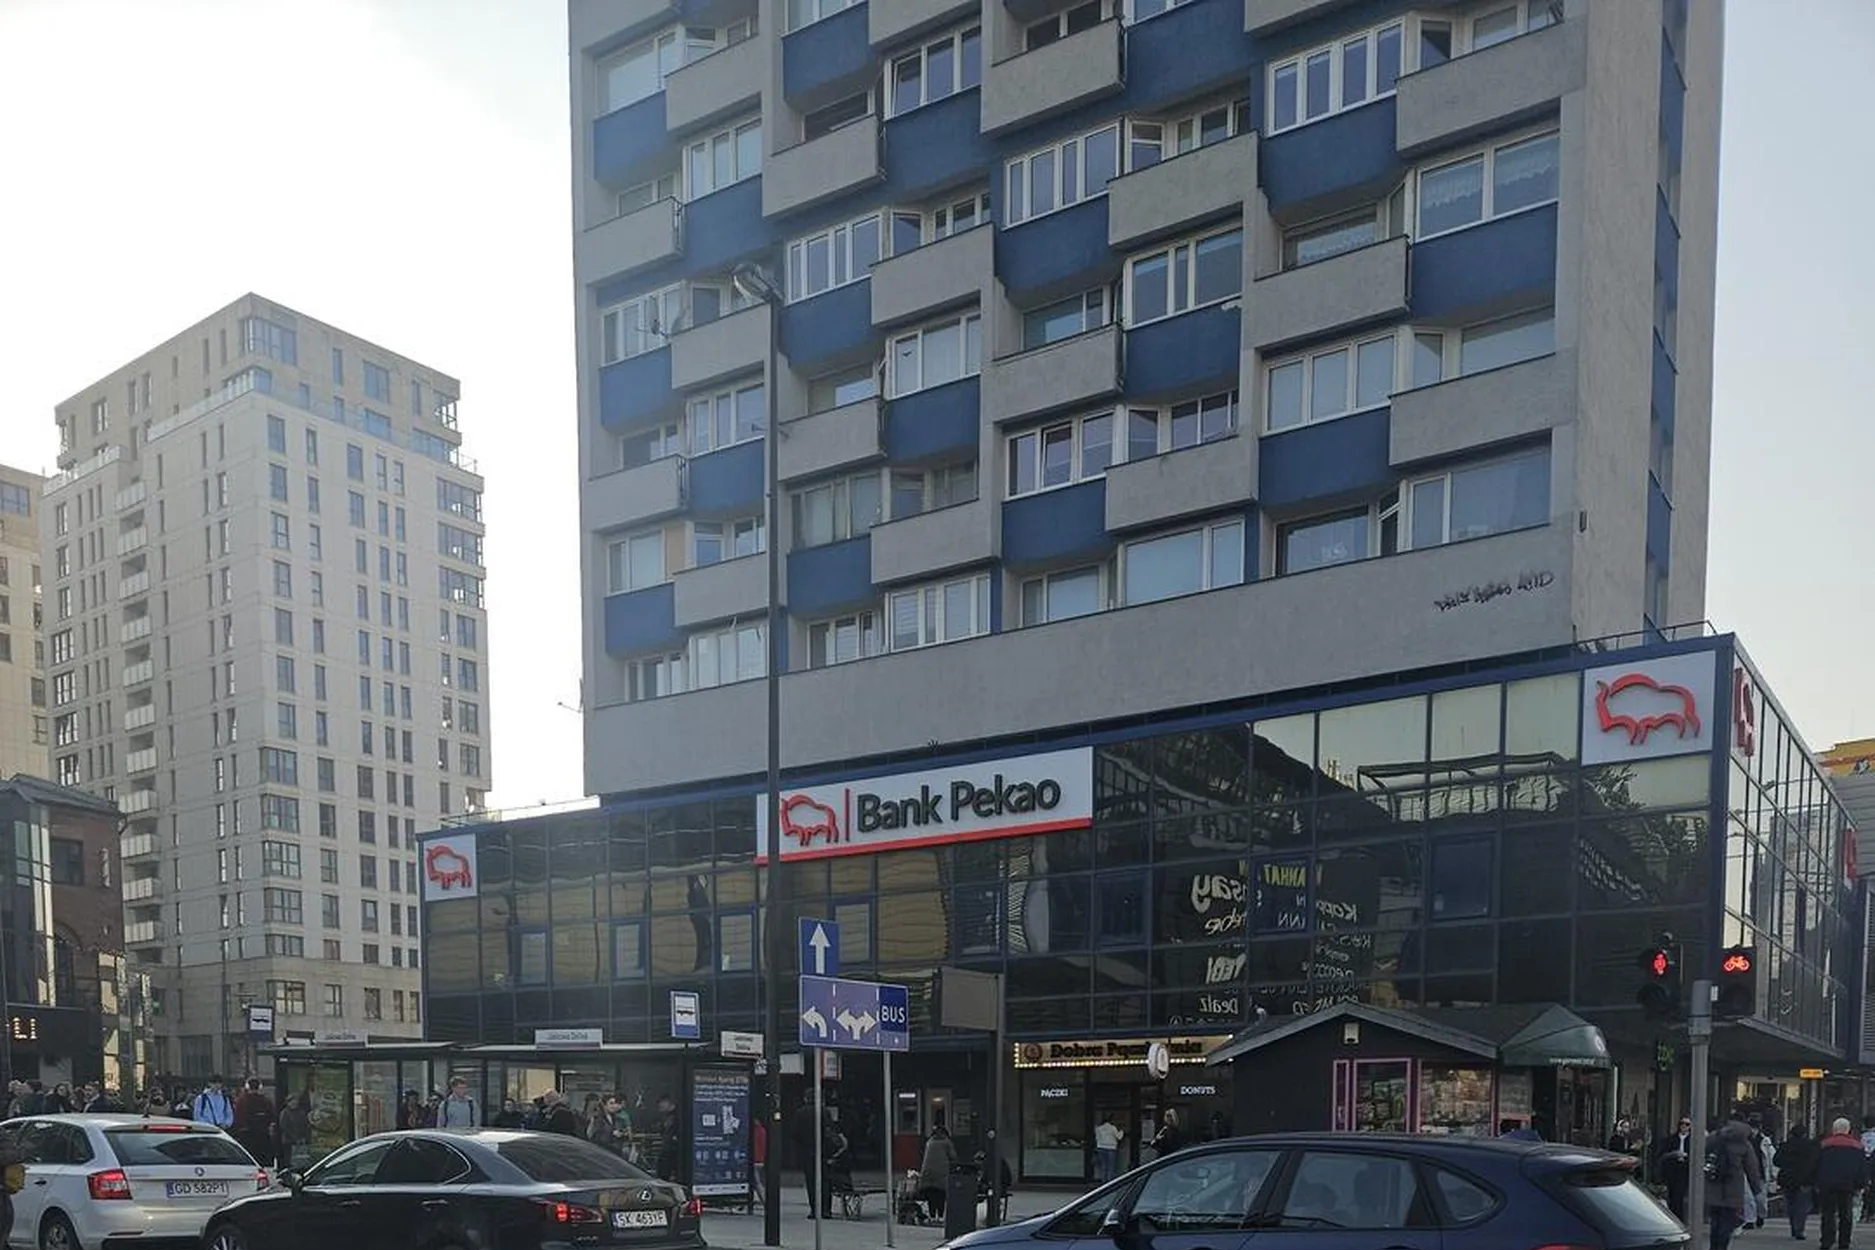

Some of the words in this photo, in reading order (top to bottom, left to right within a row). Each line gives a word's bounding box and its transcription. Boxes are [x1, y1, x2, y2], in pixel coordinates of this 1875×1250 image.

[857, 785, 943, 833] Bank
[950, 774, 1061, 822] Pekao
[881, 1005, 905, 1023] BUS
[1180, 1085, 1216, 1095] DONUTS
[175, 1182, 192, 1194] GD
